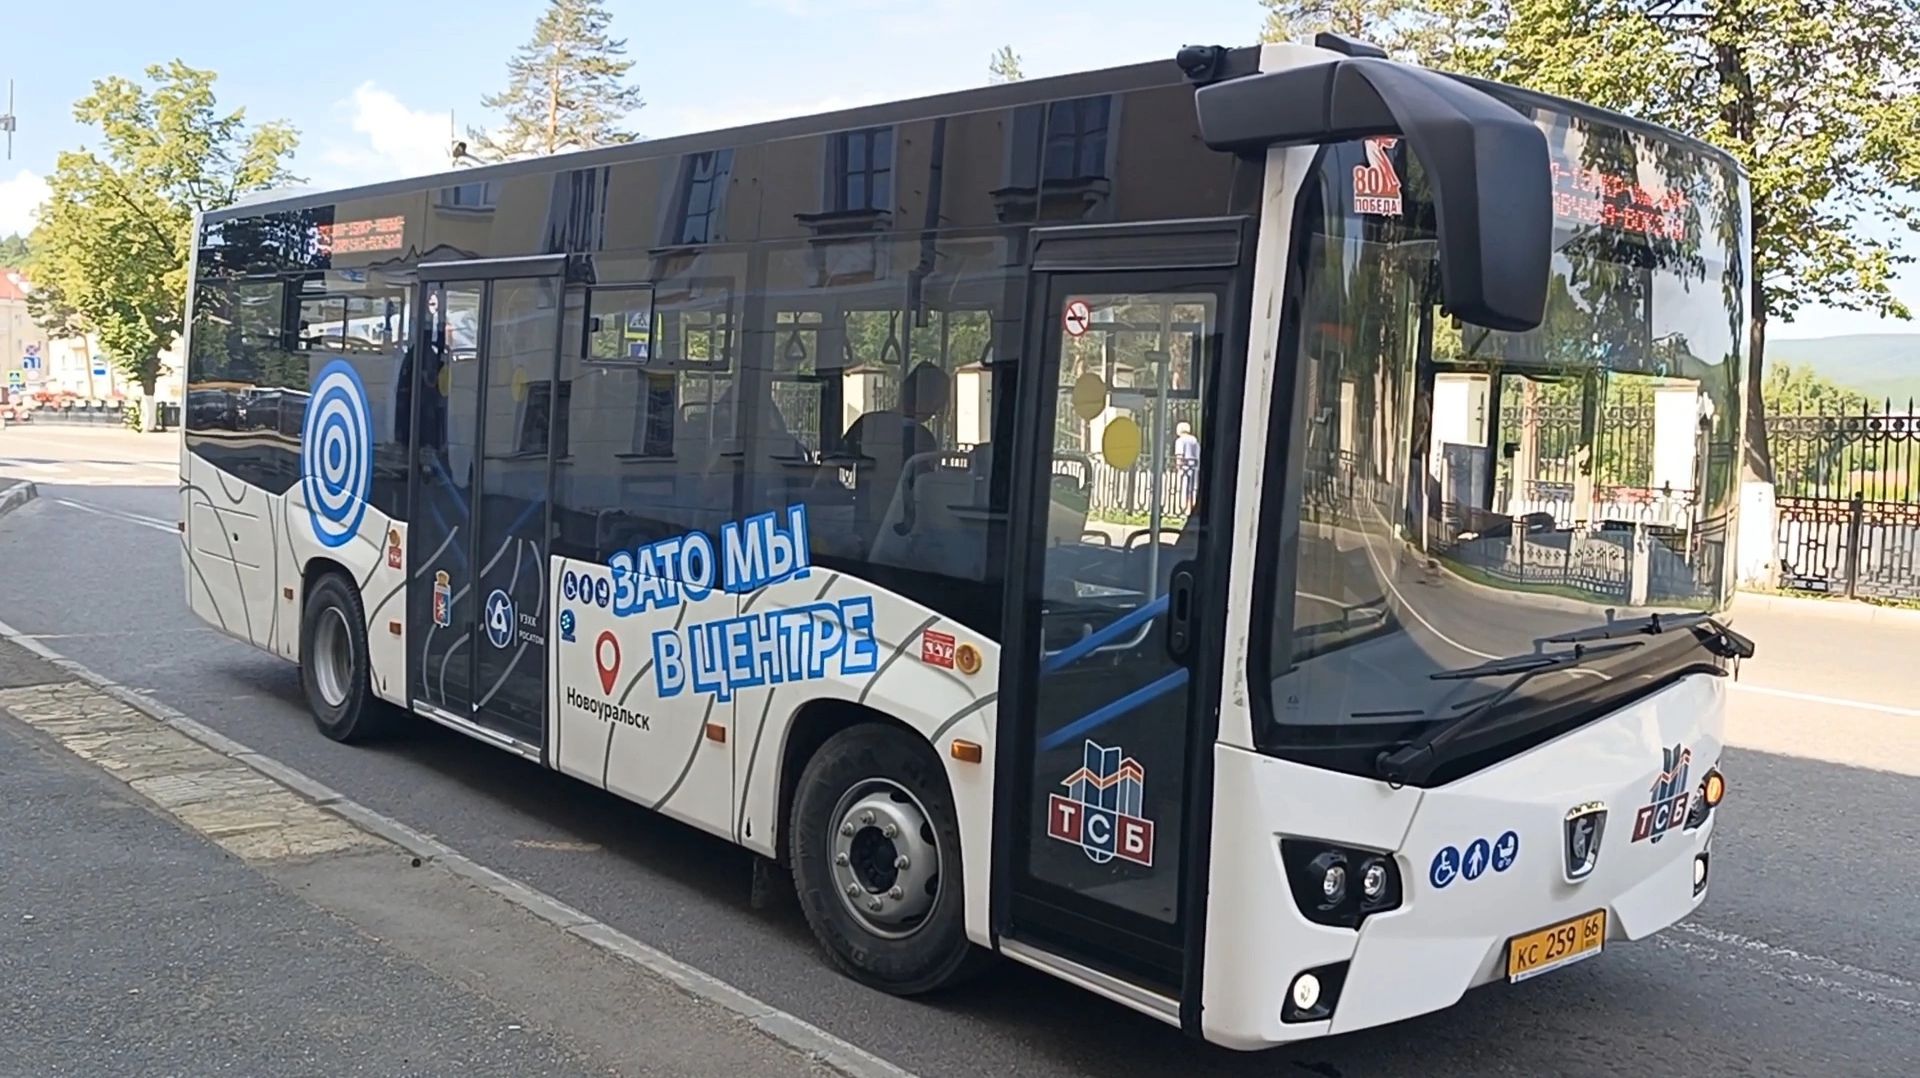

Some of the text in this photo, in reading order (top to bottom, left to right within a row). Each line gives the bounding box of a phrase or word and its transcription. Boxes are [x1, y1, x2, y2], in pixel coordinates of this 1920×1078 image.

[1354, 167, 1380, 194] 80
[609, 505, 810, 615] ЗАТО МЫ
[654, 598, 877, 702] В ЦЕНТРЕ
[566, 686, 650, 731] Новоуральск
[1058, 803, 1145, 854] ТСБ
[1640, 797, 1686, 835] ТСБ
[1517, 943, 1538, 969] КС
[1545, 926, 1576, 960] 259
[1584, 917, 1599, 938] 66
